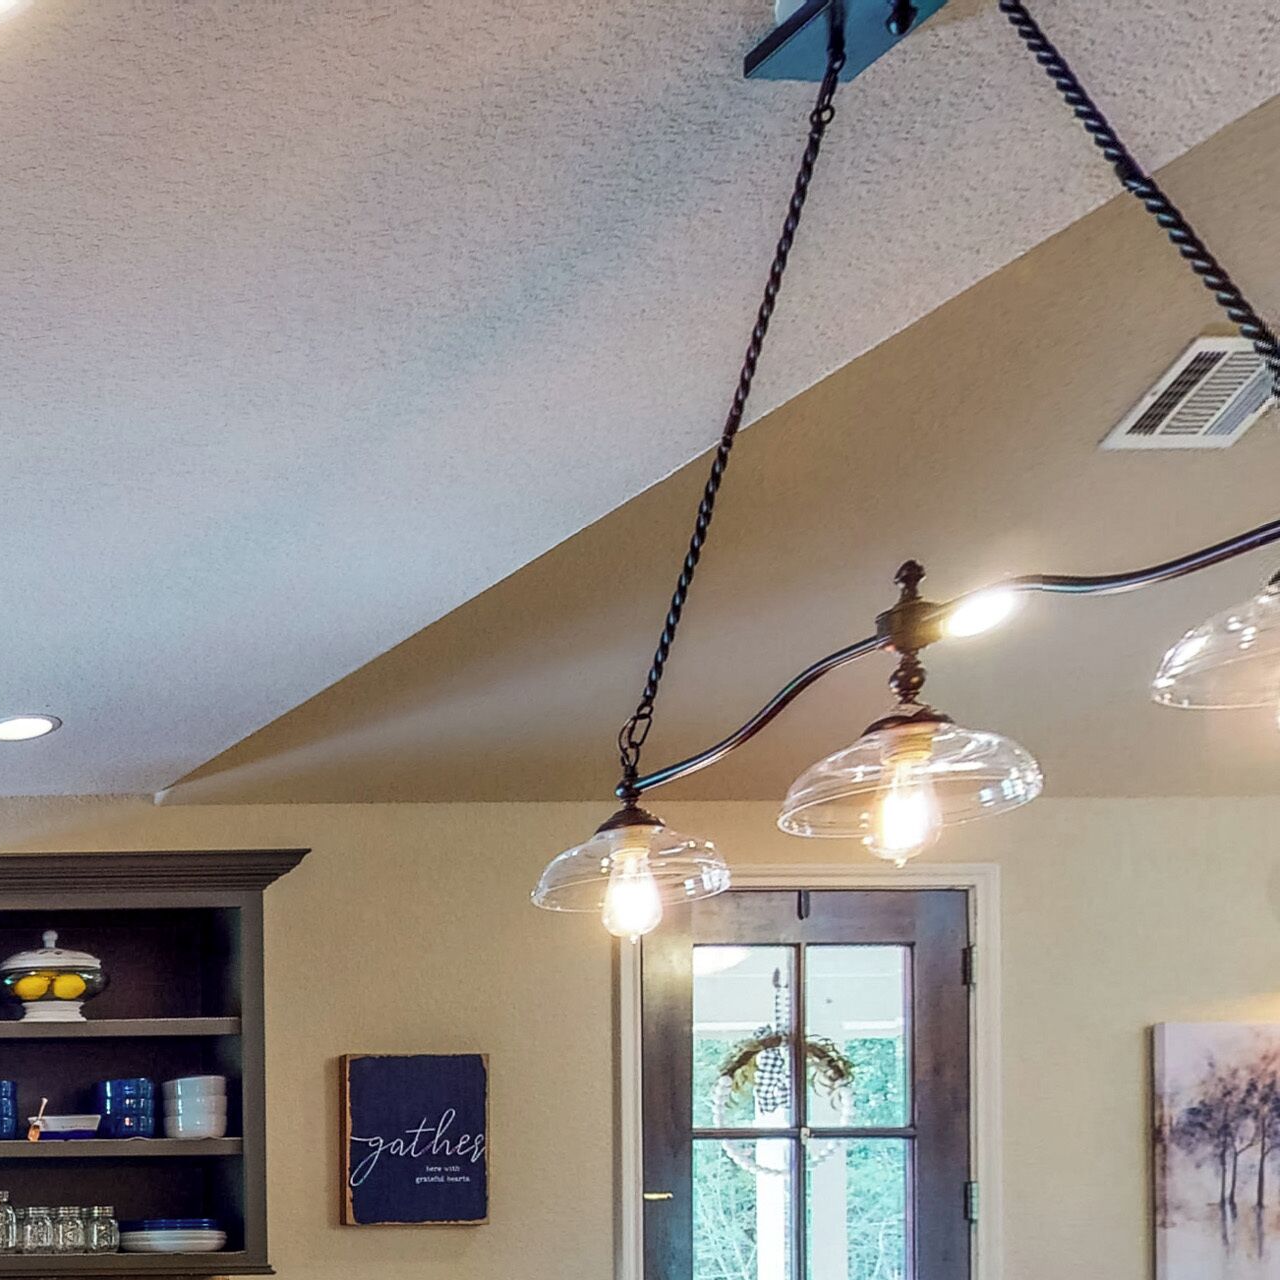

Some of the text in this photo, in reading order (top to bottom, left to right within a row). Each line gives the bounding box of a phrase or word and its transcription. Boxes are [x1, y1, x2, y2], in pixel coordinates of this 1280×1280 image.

[350, 1107, 486, 1187] gather
[425, 1164, 460, 1172] here with
[415, 1175, 445, 1185] grateful
